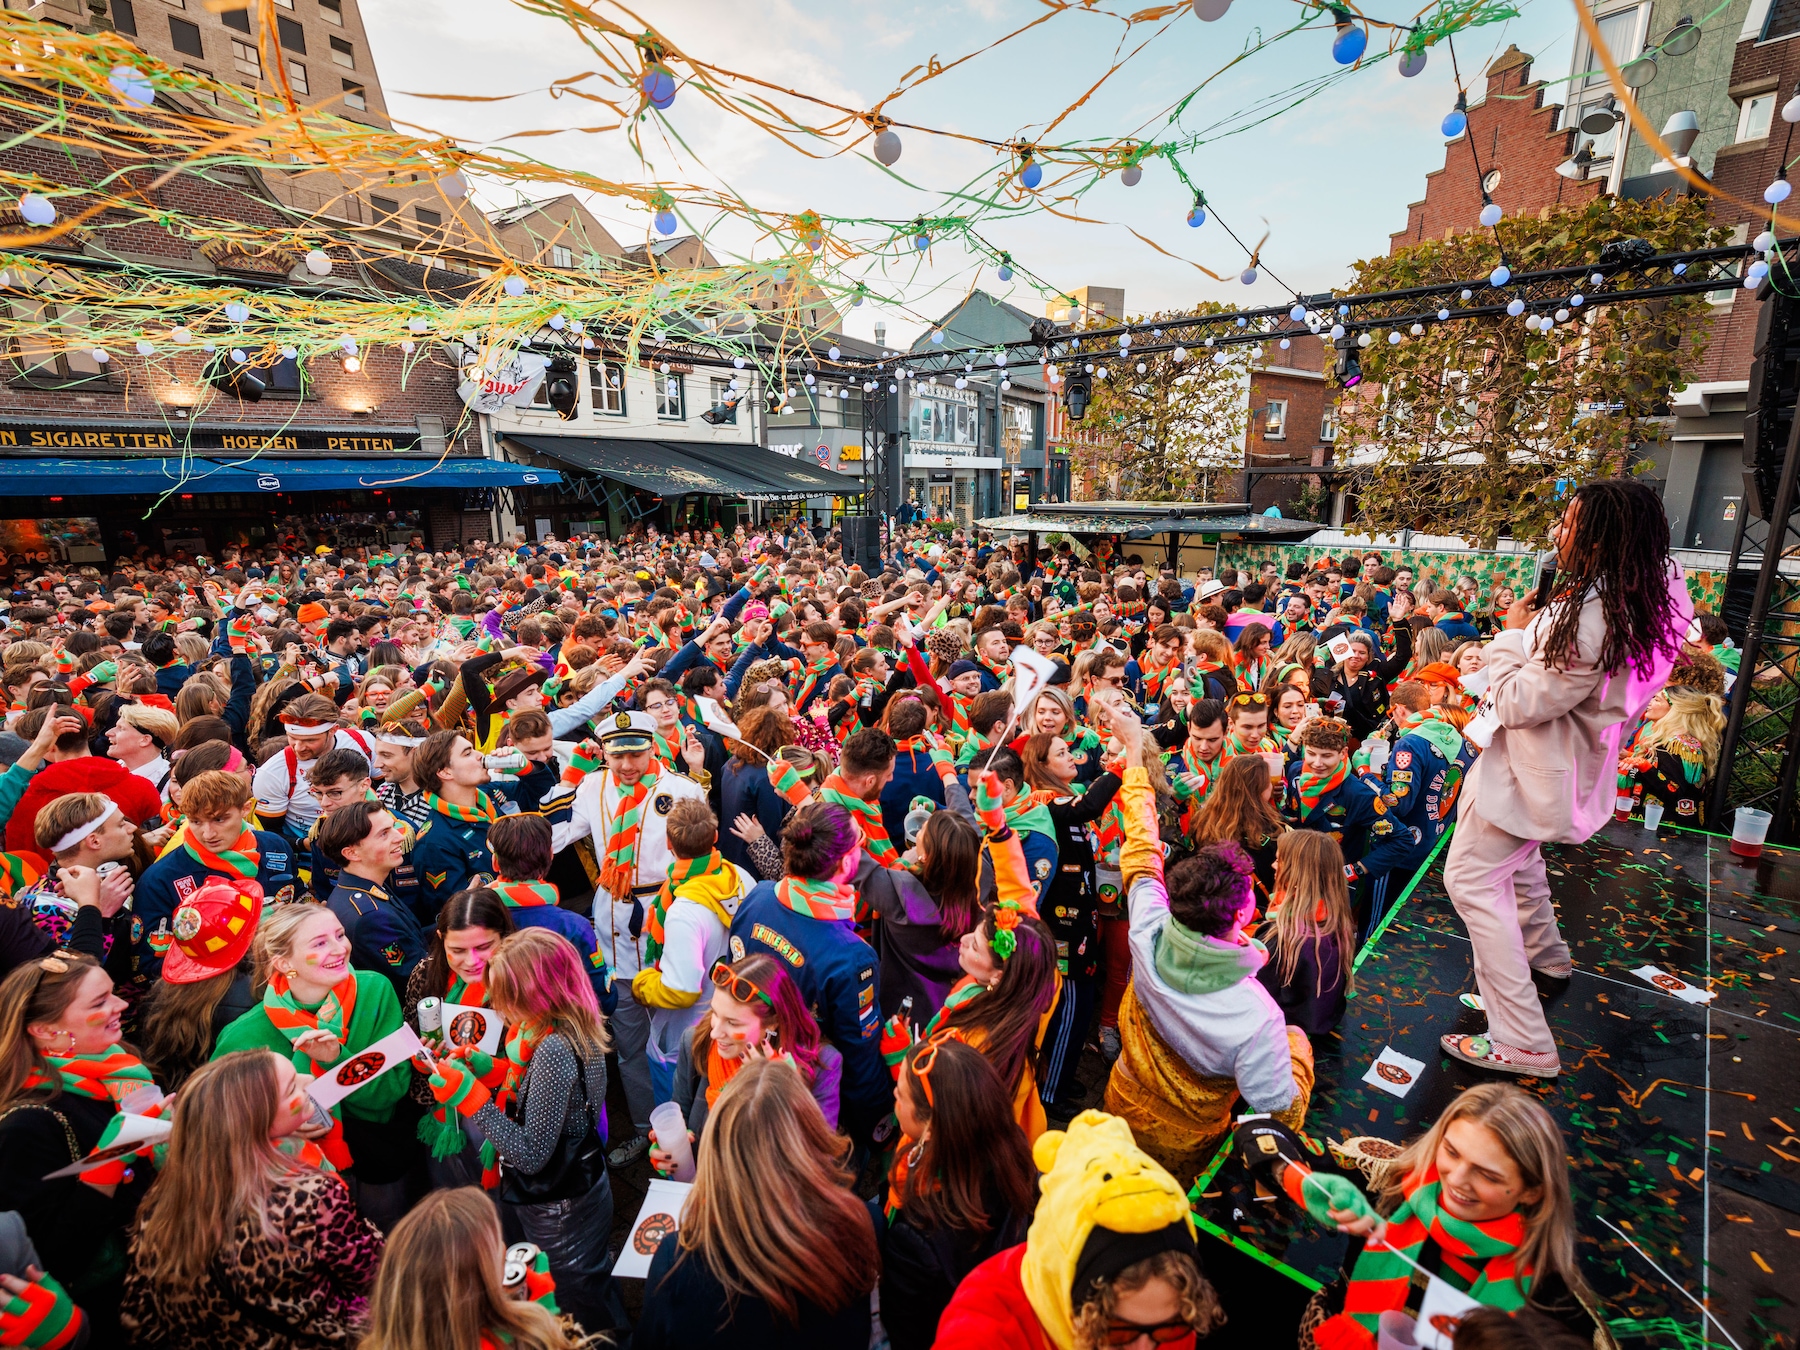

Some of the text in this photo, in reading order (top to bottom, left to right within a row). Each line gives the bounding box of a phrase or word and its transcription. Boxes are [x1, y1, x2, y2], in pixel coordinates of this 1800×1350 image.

[30, 431, 173, 448] SIGARETTEN
[222, 435, 394, 450] HOEDEN PETTEN
[1430, 770, 1446, 792] VAN
[1426, 795, 1440, 820] DEN
[752, 924, 803, 967] KRUIKENSTAD
